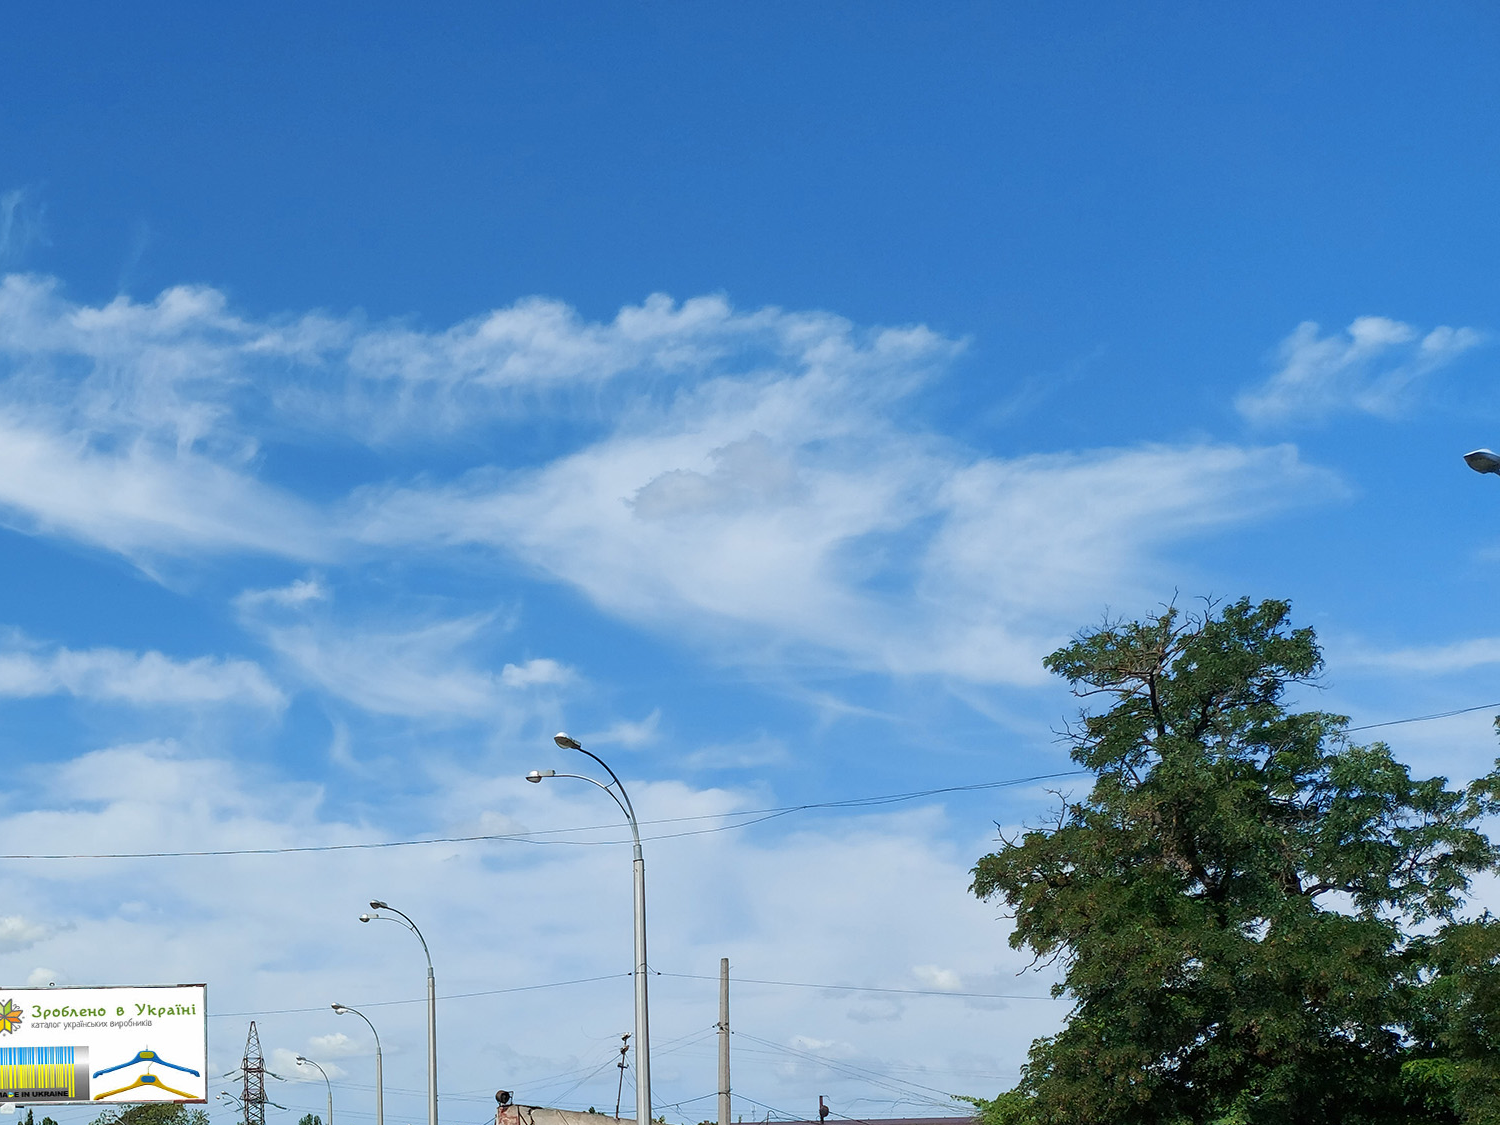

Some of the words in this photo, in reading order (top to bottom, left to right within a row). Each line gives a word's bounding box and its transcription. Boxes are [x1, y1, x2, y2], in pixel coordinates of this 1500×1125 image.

[31, 1005, 107, 1020] Зроблено
[116, 1006, 125, 1016] в
[135, 1003, 196, 1018] Україні
[31, 1021, 60, 1029] каталог
[63, 1020, 108, 1030] українських
[109, 1018, 153, 1029] виробників
[32, 1090, 69, 1098] UKRAINE
